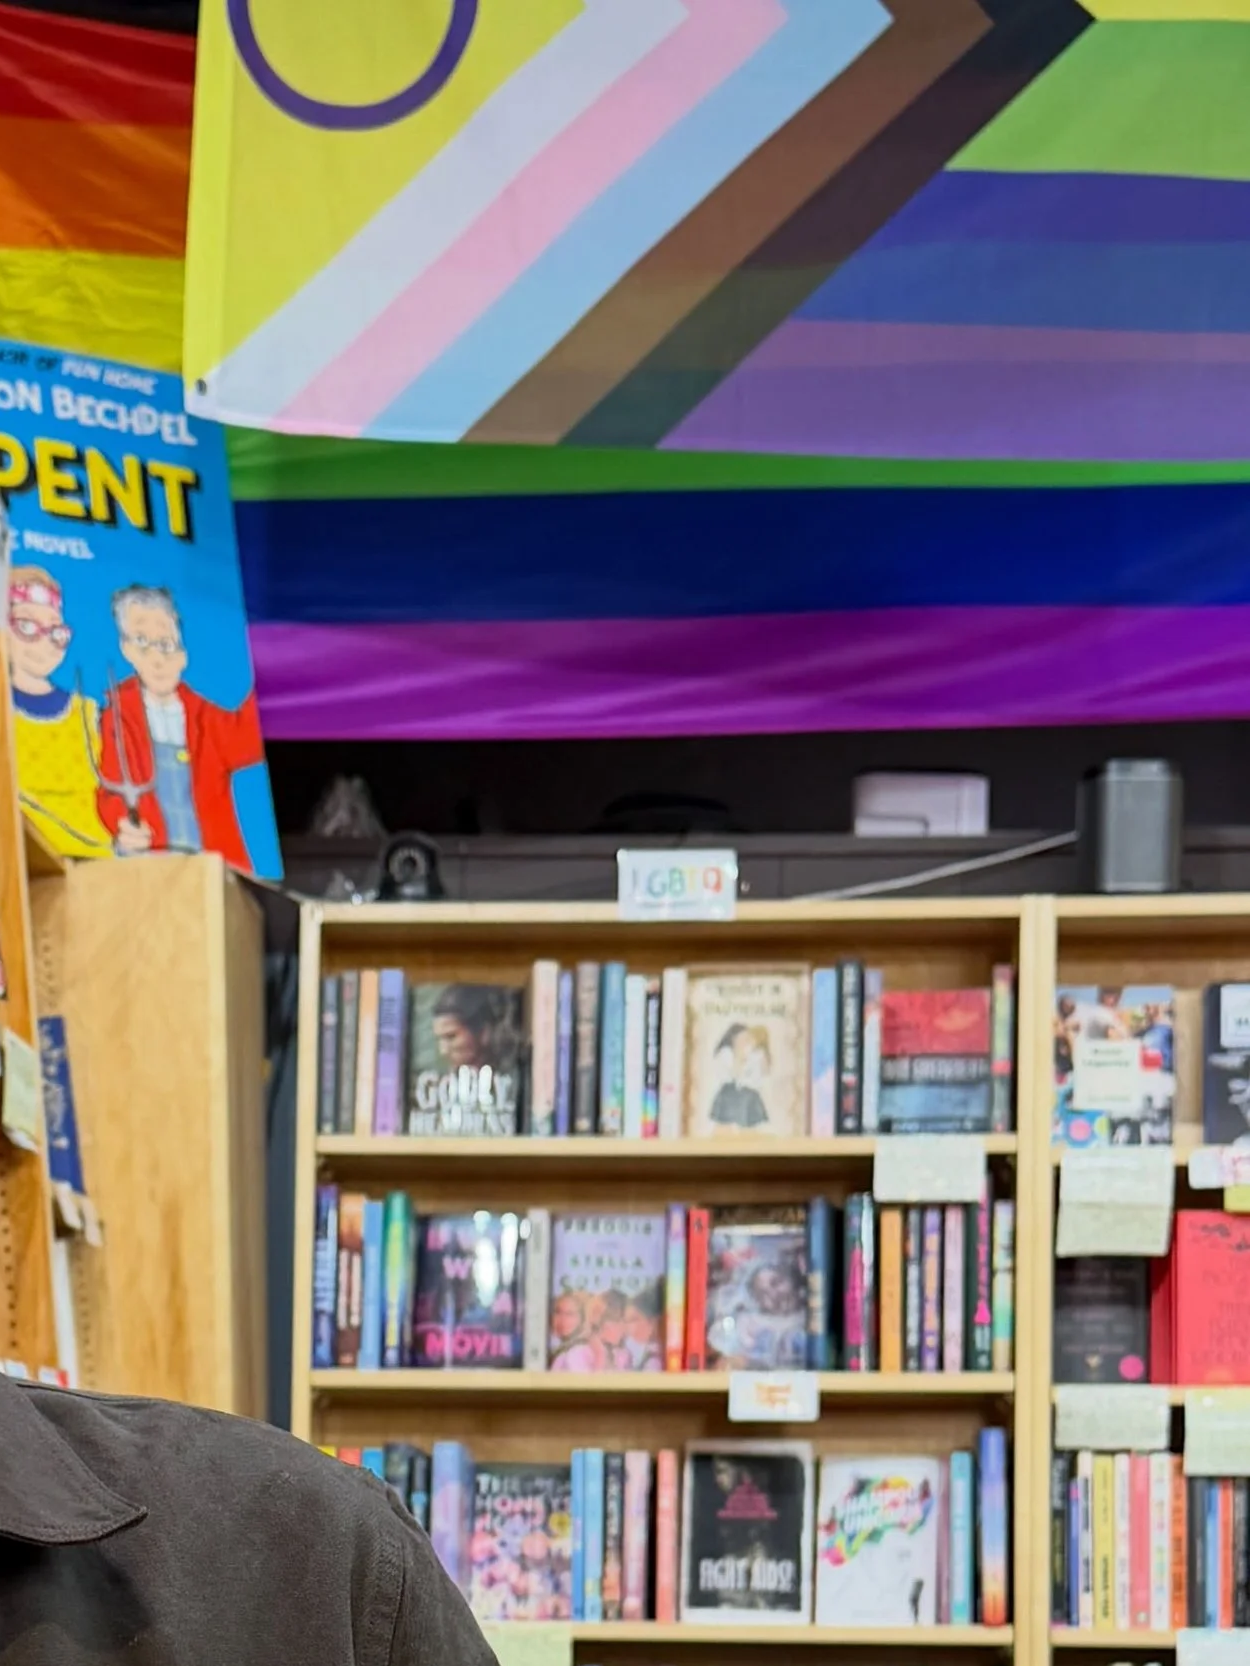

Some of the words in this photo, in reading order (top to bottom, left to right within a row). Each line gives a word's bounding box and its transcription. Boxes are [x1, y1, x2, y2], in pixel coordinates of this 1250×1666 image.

[35, 355, 59, 371] OF
[61, 357, 102, 381] FUN
[103, 368, 158, 396] HOME
[52, 385, 198, 446] BECHDEL
[23, 529, 95, 560] NOVEL
[631, 865, 723, 898] LGBTQ
[425, 1332, 512, 1358] MOVIE
[700, 1558, 748, 1592] FIGHT
